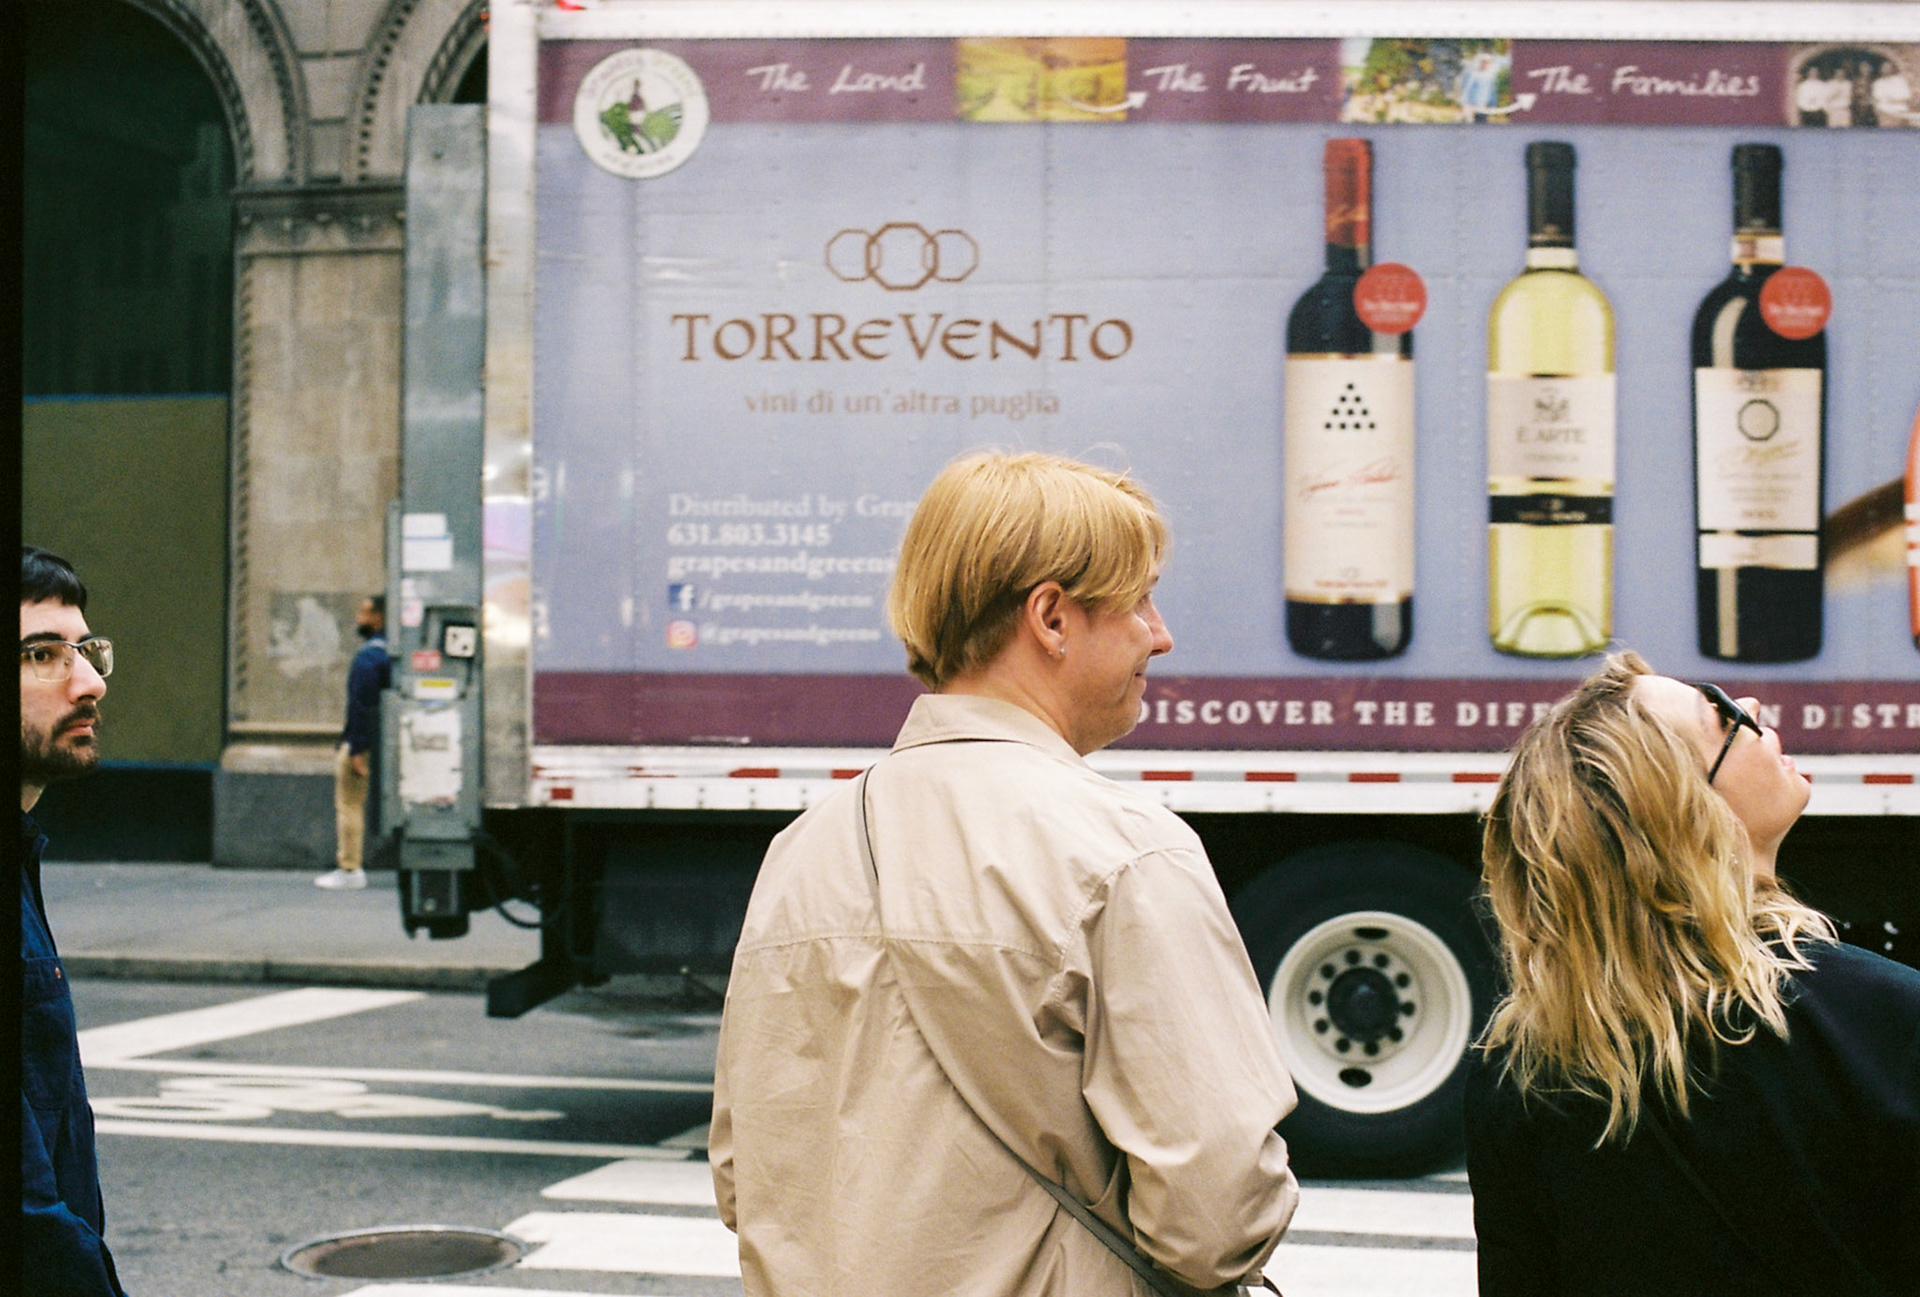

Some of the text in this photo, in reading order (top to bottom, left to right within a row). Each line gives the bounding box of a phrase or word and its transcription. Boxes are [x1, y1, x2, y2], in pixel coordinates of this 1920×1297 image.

[746, 63, 926, 95] The Land
[1144, 63, 1319, 93] The Fruit
[1528, 65, 1760, 97] The Families
[671, 314, 1135, 361] TORREVENTO
[745, 391, 798, 414] vini
[807, 389, 834, 414] di
[971, 389, 1060, 421] puglia
[668, 494, 812, 517] Distributed
[819, 494, 848, 523] by
[667, 524, 831, 546] 631.803.3145
[1355, 702, 1436, 726] THE
